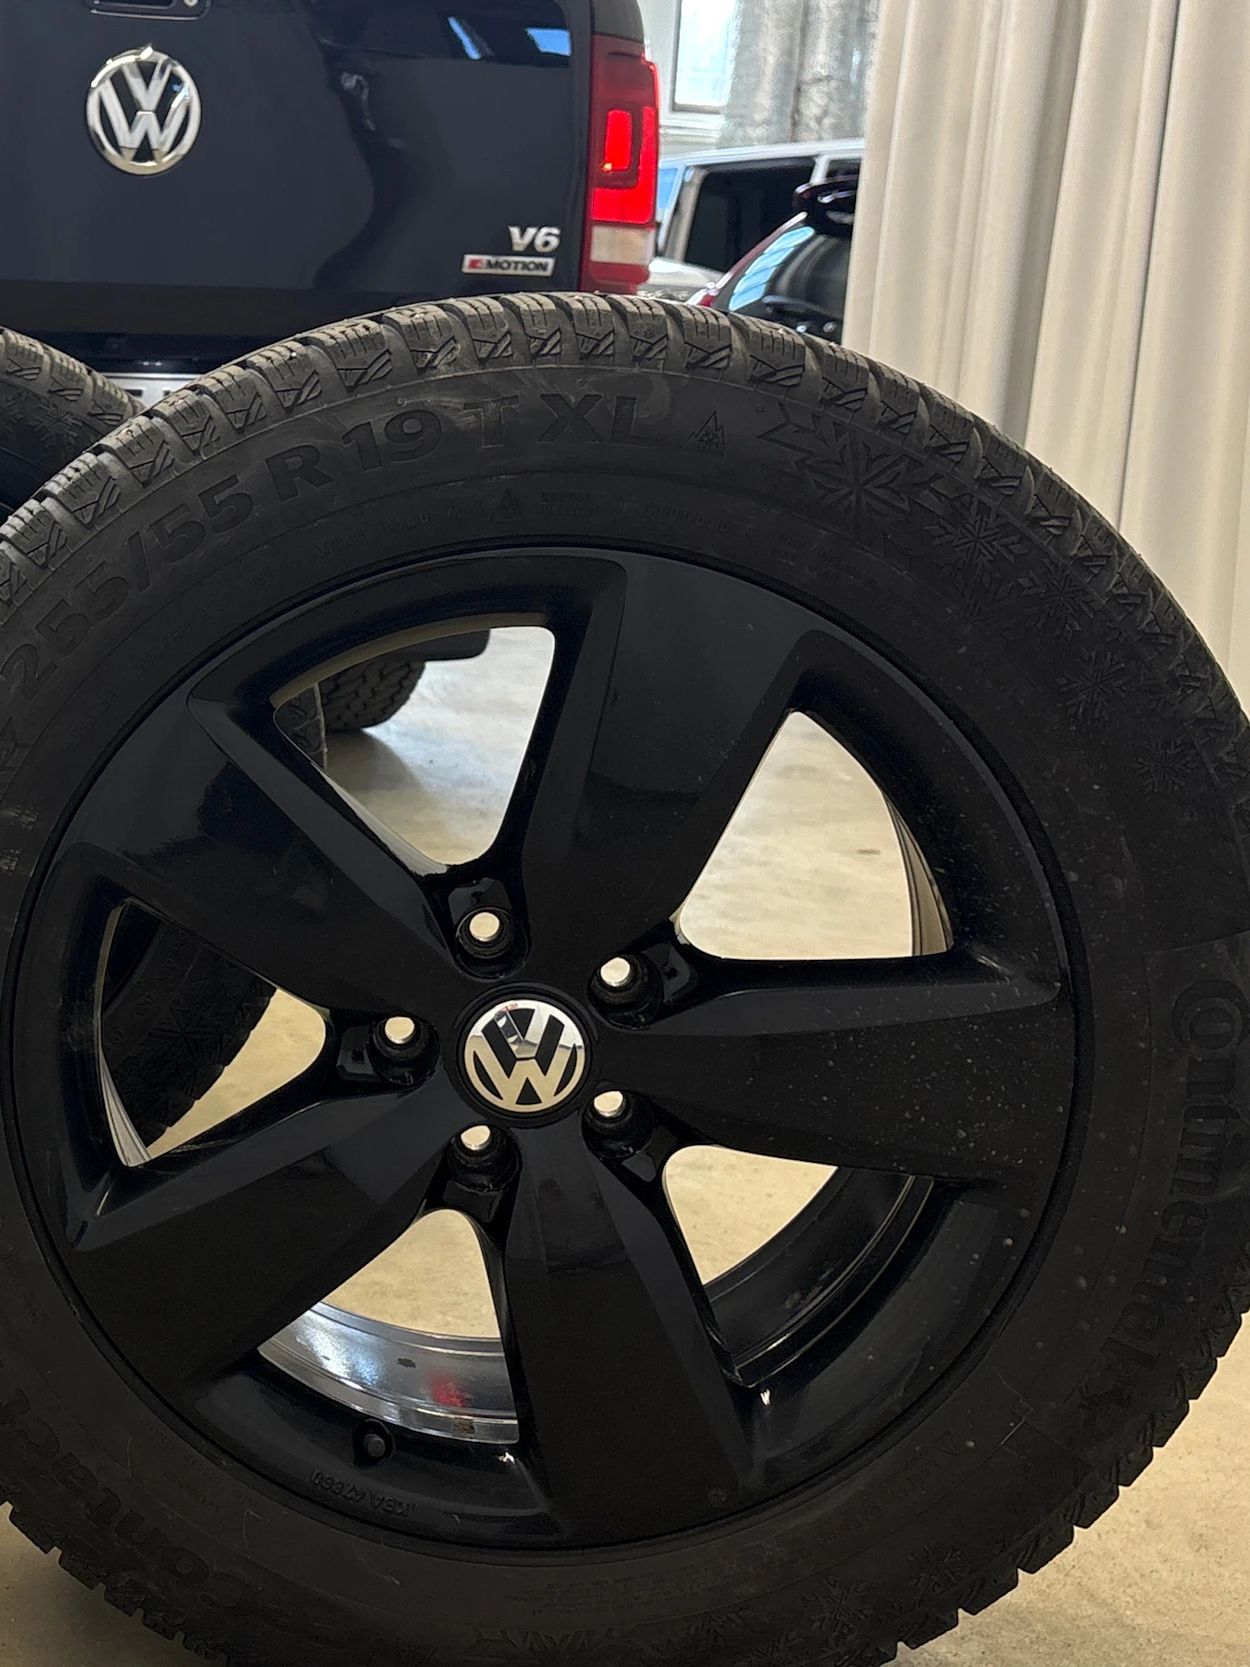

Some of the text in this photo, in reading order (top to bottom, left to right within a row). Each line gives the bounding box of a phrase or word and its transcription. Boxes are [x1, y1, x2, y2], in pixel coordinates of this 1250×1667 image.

[507, 225, 561, 253] V6
[260, 438, 335, 502] R
[339, 405, 445, 474] 19
[462, 395, 519, 450] T
[537, 391, 666, 452] XL
[1101, 976, 1250, 1378] Continental
